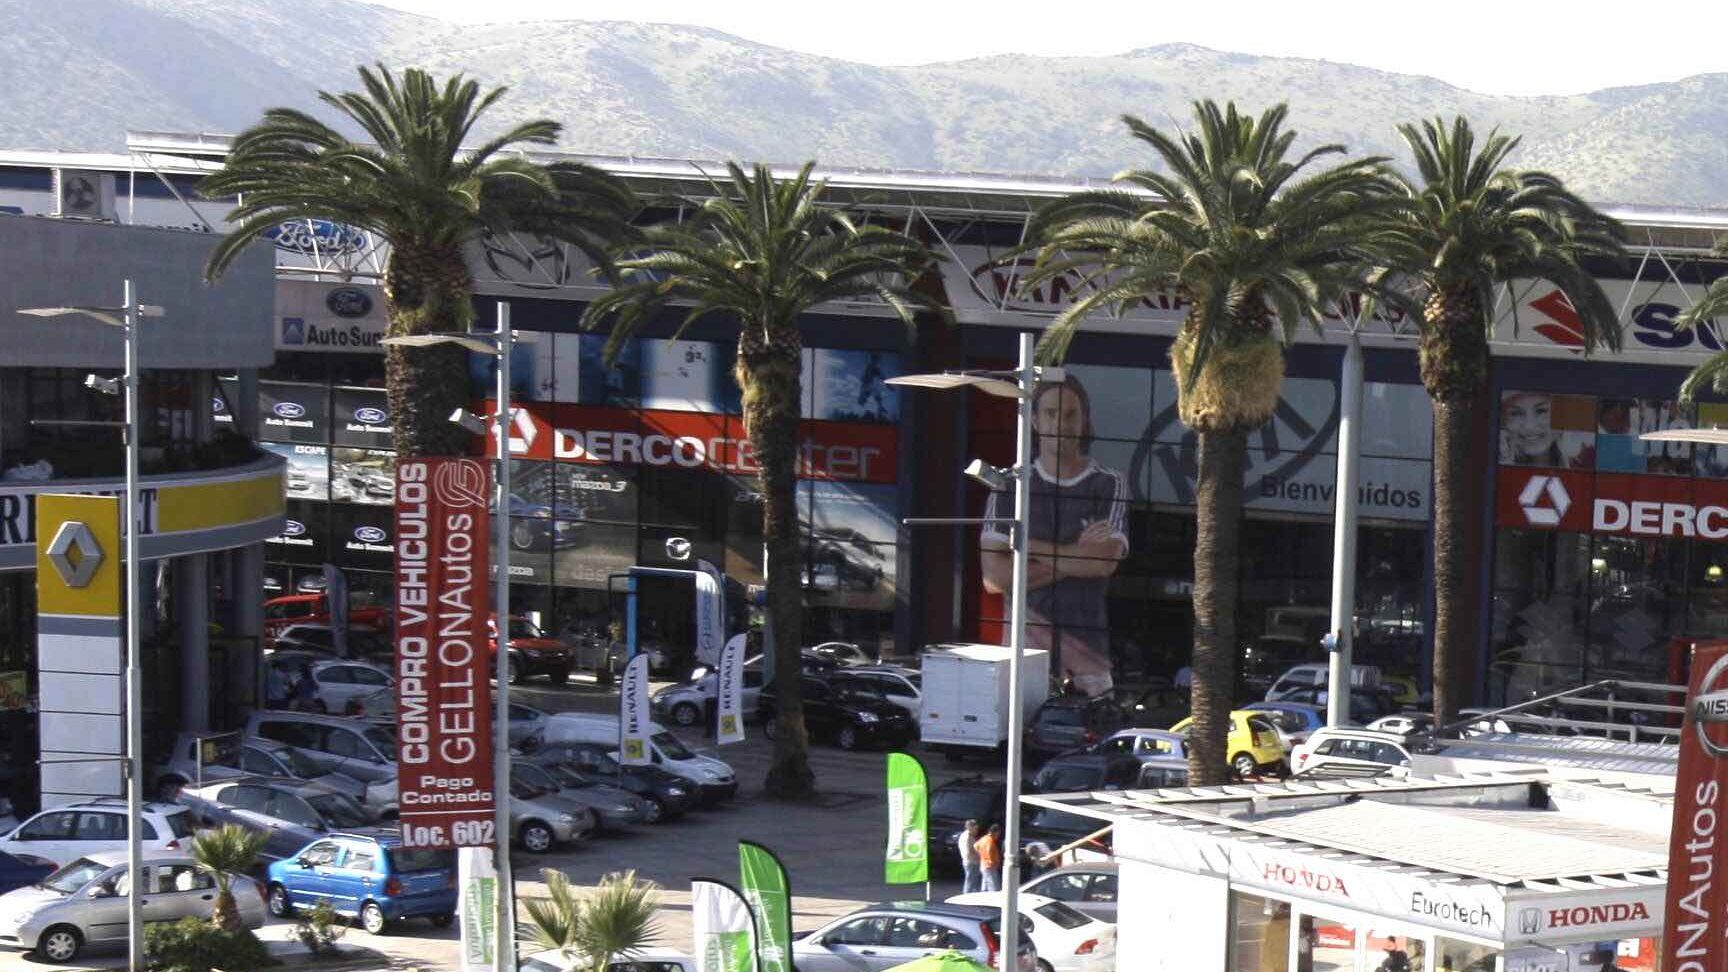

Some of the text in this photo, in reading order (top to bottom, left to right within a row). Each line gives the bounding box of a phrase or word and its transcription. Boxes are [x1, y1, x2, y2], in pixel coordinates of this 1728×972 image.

[553, 428, 880, 478] DERCOceter
[1259, 475, 1421, 509] Bienvidos
[399, 462, 430, 764] COMPRO VEHICULOS
[438, 513, 476, 764] GELLONAutos
[402, 789, 493, 805] Contado
[420, 775, 474, 790] Pago
[452, 820, 495, 845] 602
[1263, 862, 1350, 897] HONDA
[1411, 891, 1492, 928] Eurotech
[1547, 901, 1651, 928] HONDA
